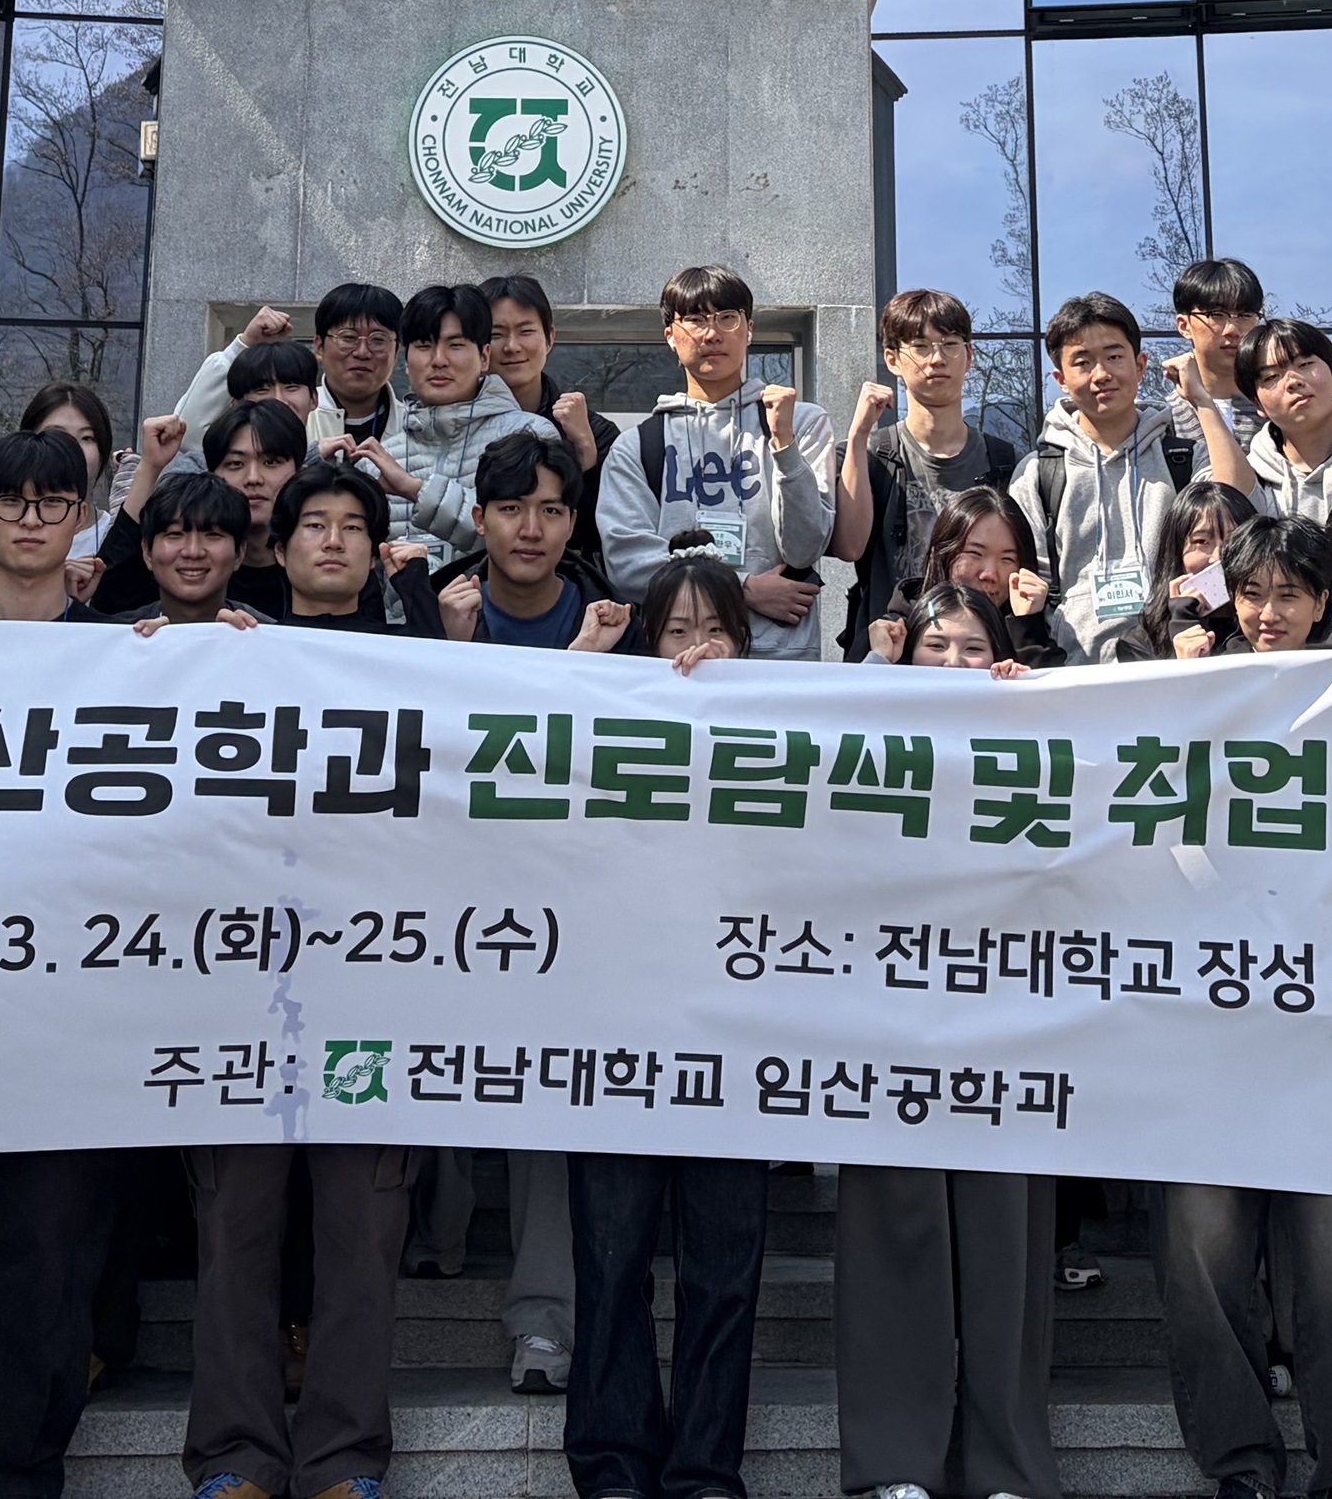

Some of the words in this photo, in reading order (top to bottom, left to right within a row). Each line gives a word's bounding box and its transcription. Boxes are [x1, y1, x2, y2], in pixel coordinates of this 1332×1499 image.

[436, 46, 596, 100] 전남대학교
[420, 134, 471, 217] CHONNAM
[468, 209, 559, 236] NATIONAL
[562, 136, 614, 220] UNIVERSITY
[664, 444, 762, 507] Lee
[464, 712, 934, 839] 진로탐색
[968, 737, 1076, 849] 및
[79, 905, 560, 976] 24.(화)~25.(수)
[715, 913, 855, 981] 장소:
[874, 922, 1182, 1001] 전남대학교
[1196, 938, 1316, 1014] 장성
[142, 1039, 298, 1109] 주관:
[406, 1042, 726, 1110] 전남대학교
[754, 1054, 1076, 1131] 임산공학과
